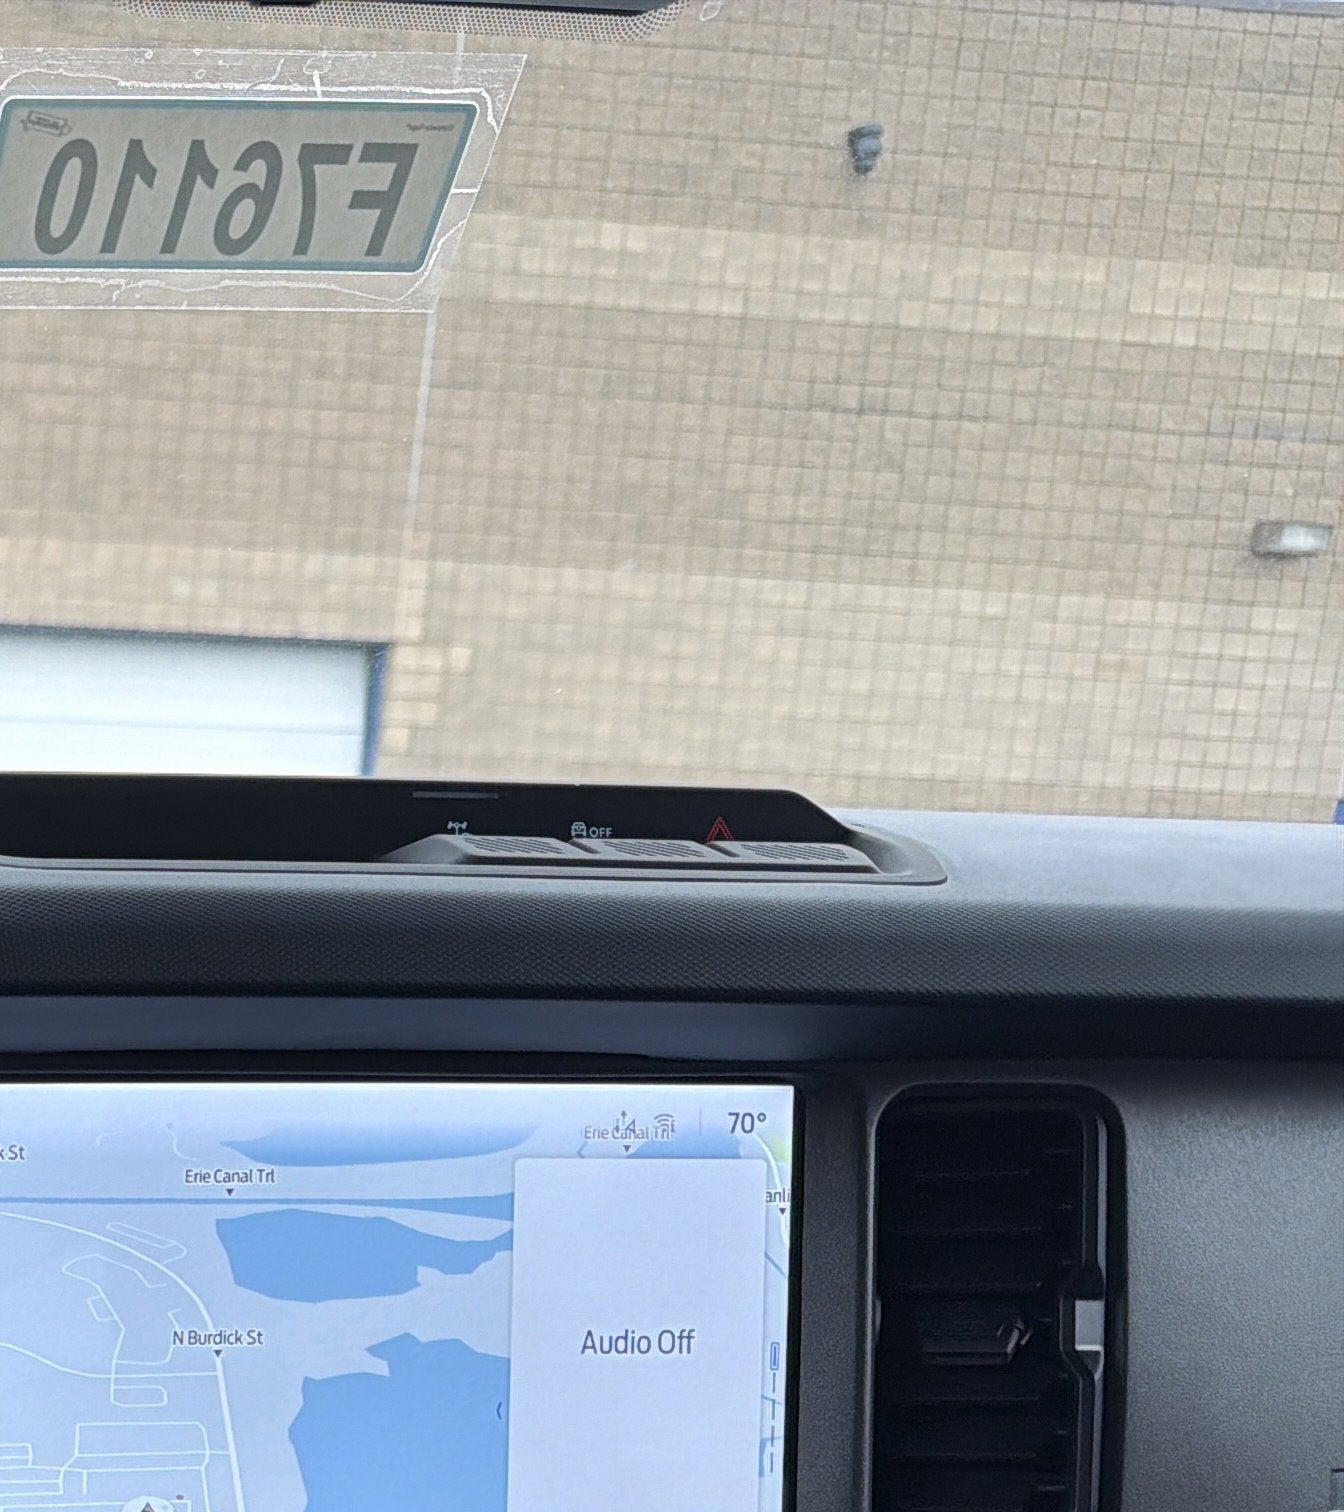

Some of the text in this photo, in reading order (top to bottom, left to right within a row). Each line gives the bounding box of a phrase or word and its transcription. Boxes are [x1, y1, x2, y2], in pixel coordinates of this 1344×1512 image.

[589, 827, 612, 838] OFF
[728, 1112, 767, 1134] 70°
[8, 1145, 25, 1161] St
[185, 1168, 276, 1185] Erie Canal Trl
[173, 1329, 264, 1347] N Burdick St
[580, 1329, 696, 1355] Audio Off
